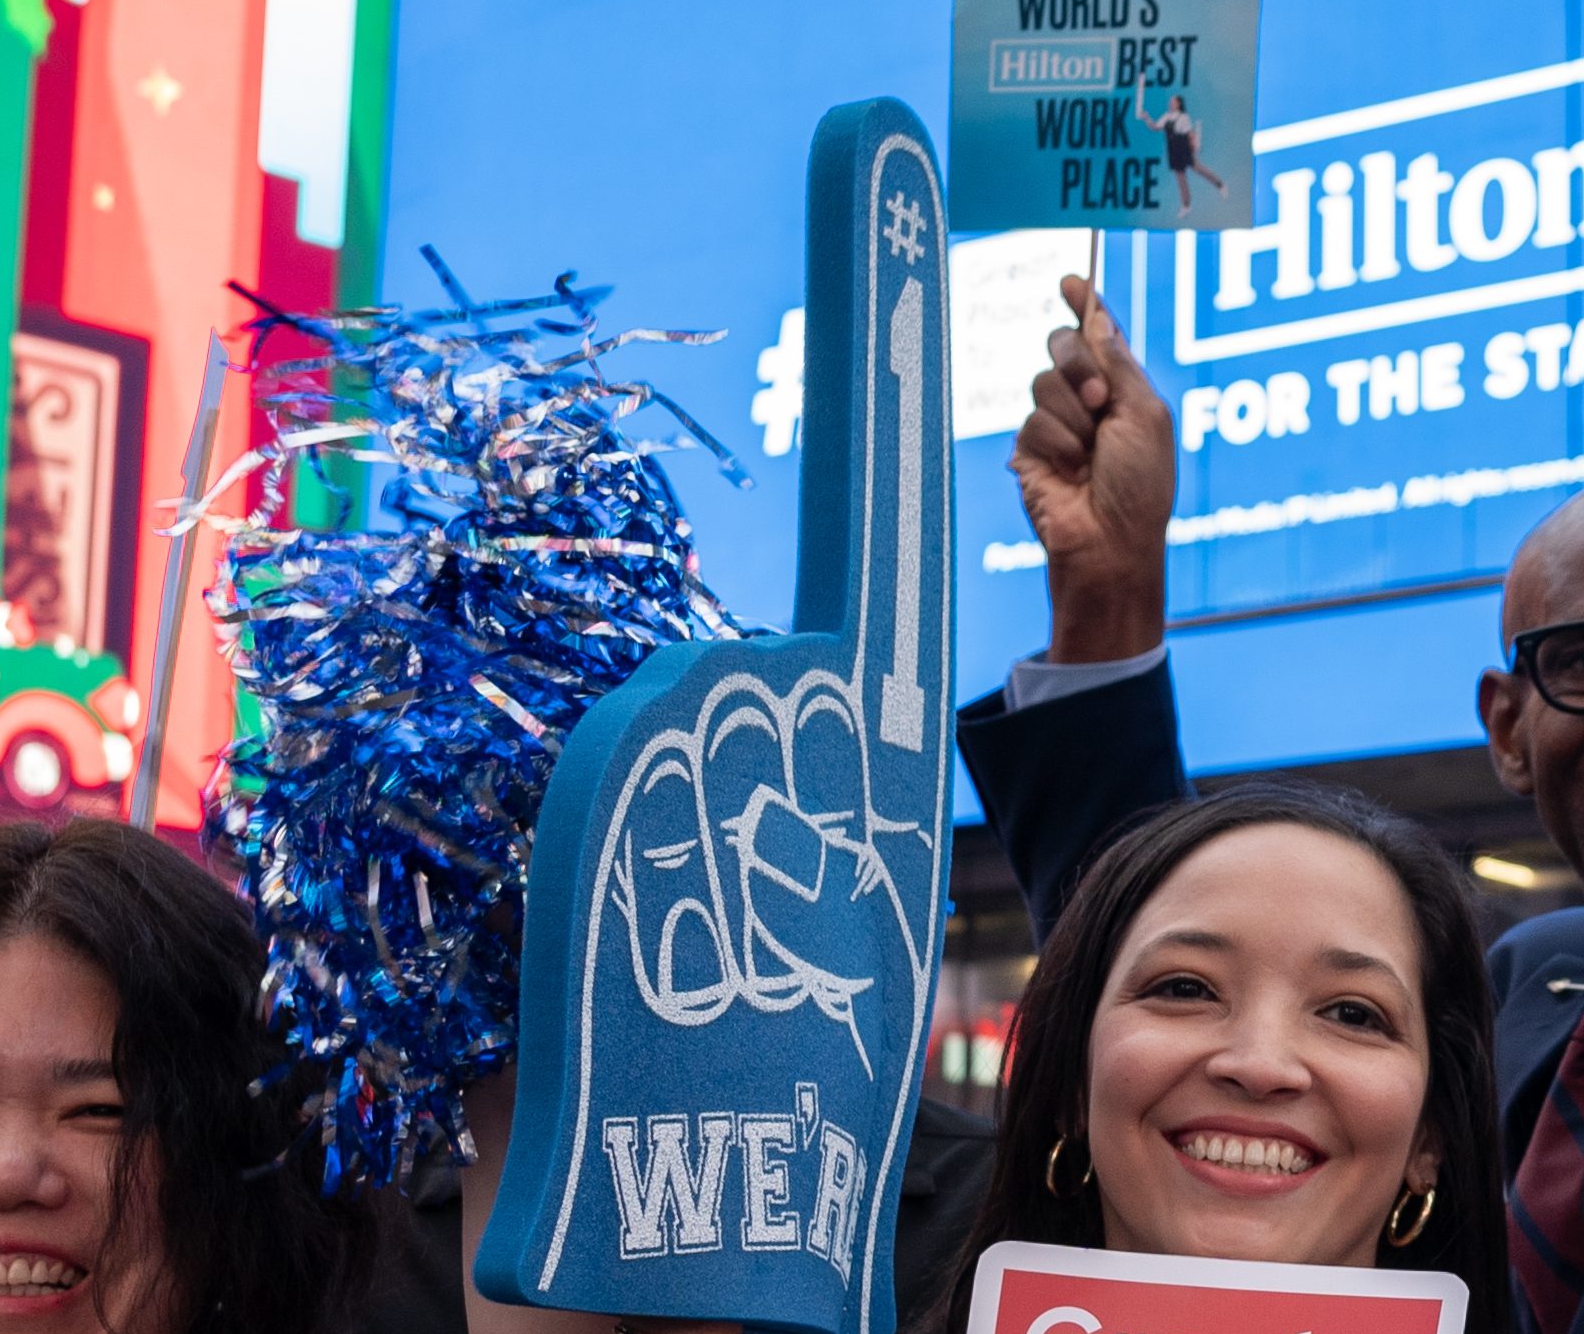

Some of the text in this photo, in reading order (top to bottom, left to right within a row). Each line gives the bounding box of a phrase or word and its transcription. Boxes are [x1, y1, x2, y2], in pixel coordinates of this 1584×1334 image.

[1000, 35, 1198, 88] Hilton BEST
[1036, 97, 1131, 149] WORK
[1060, 157, 1160, 210] PLACE
[1182, 374, 1311, 454] FOR
[1327, 341, 1464, 427] THE
